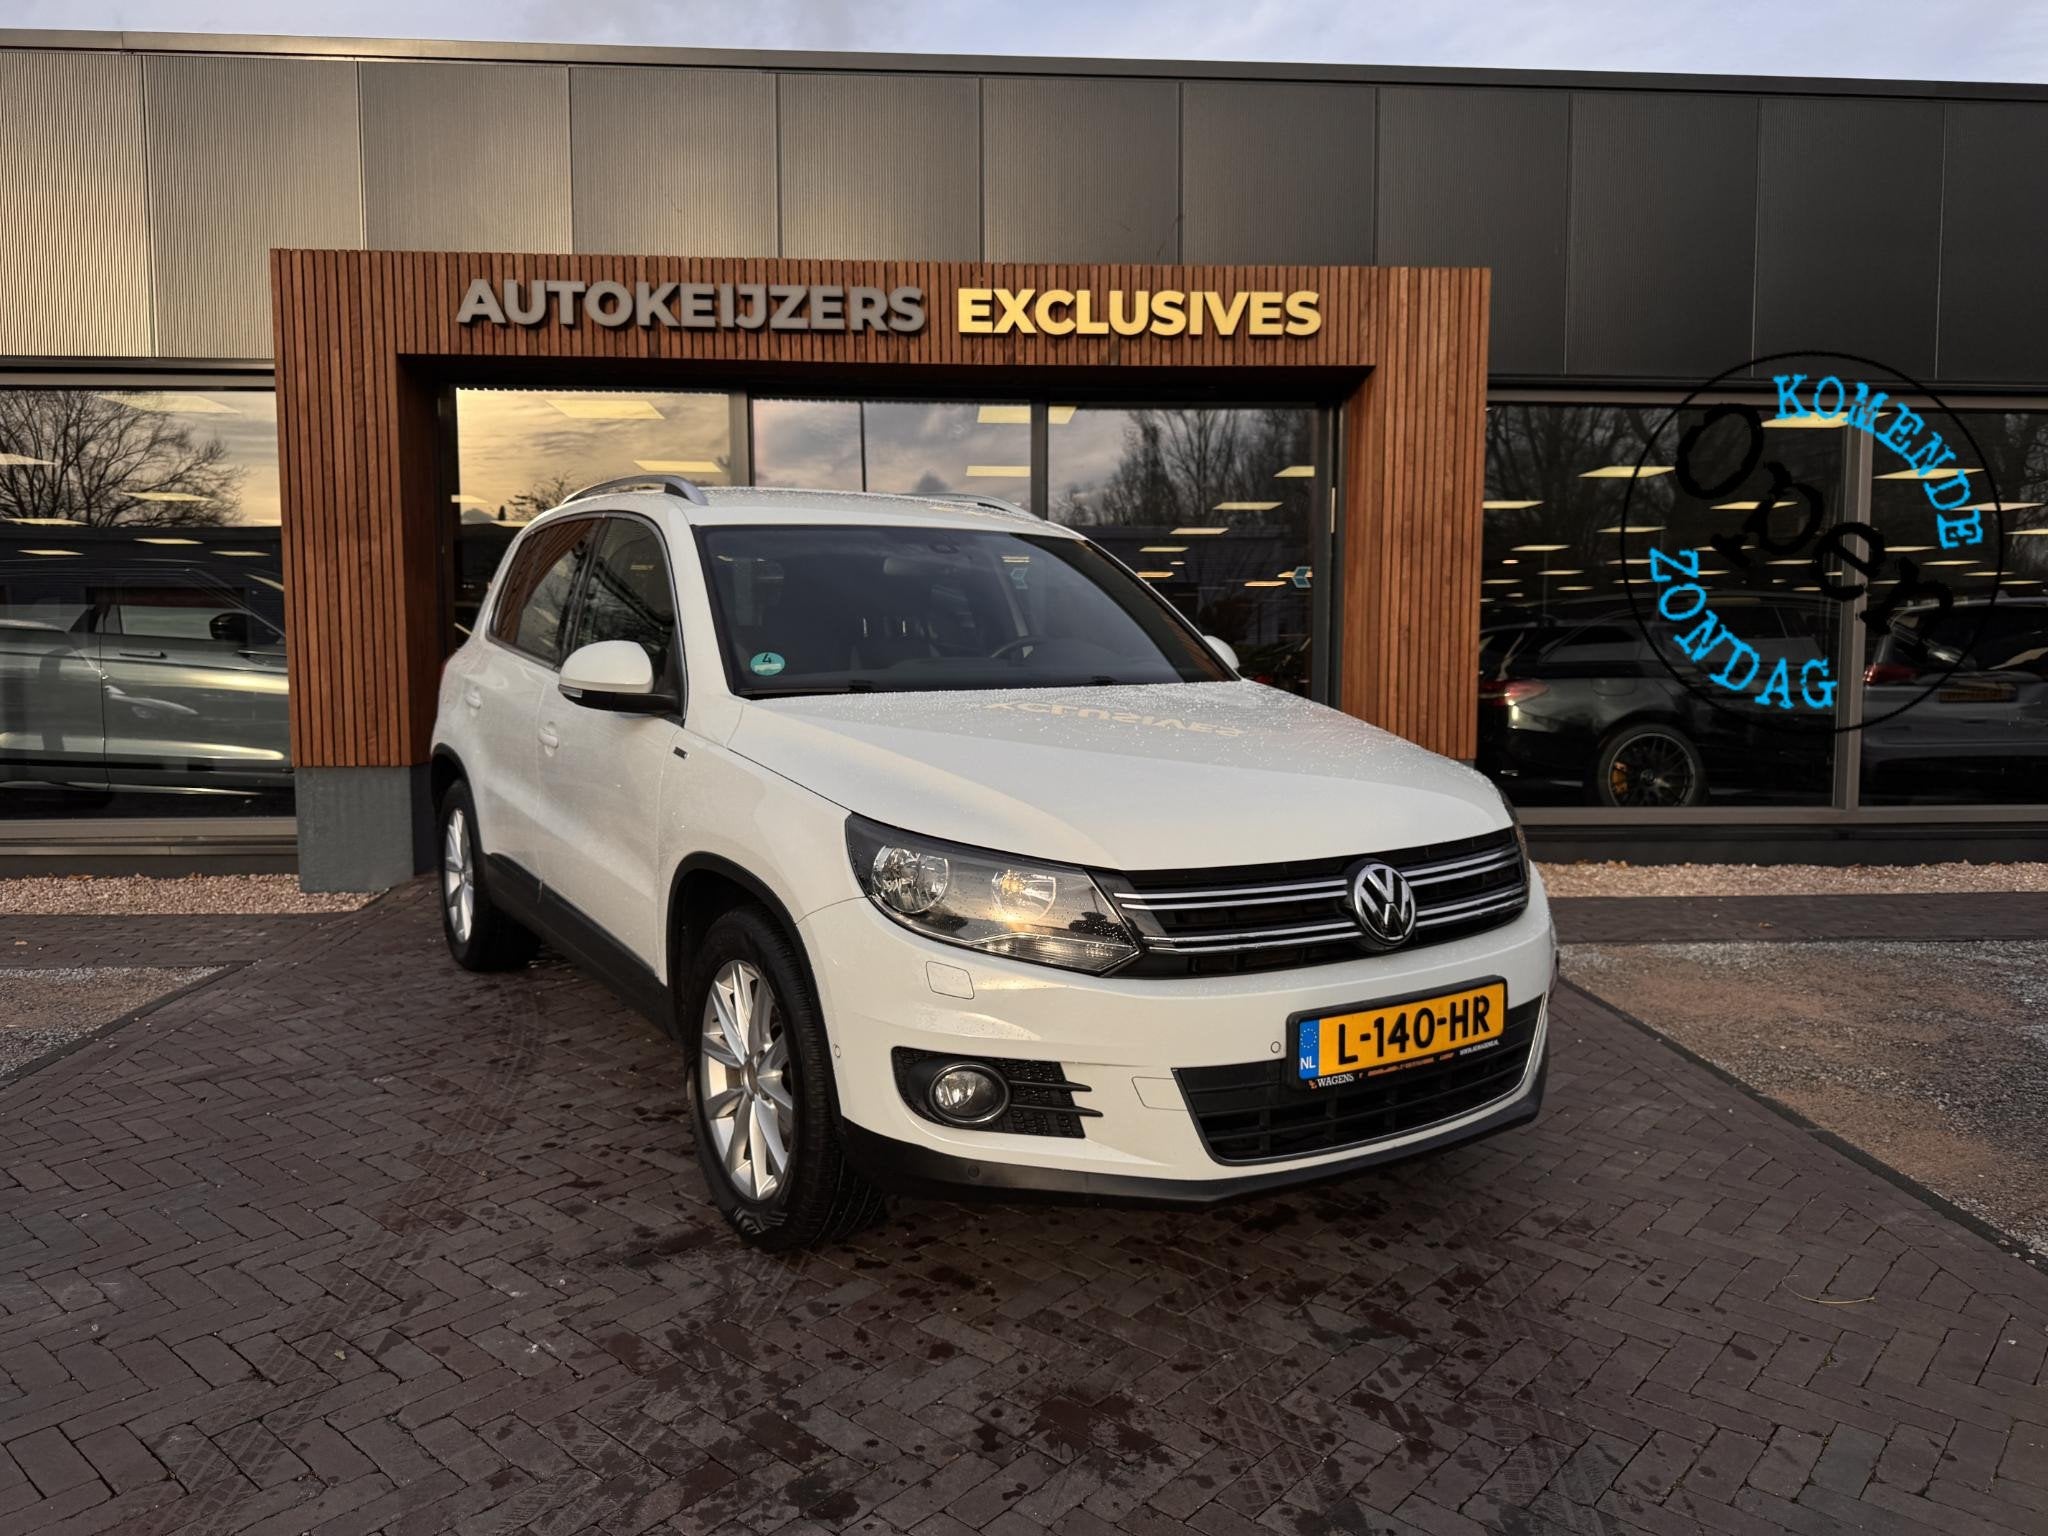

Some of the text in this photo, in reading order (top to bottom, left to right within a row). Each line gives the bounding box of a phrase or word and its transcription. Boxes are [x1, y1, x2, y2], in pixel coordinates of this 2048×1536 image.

[456, 278, 1323, 337] AUTOKEIJZERS EXCLUSIVES
[762, 653, 772, 664] 4
[1338, 994, 1491, 1066] L-140-HR
[1300, 1056, 1317, 1071] NL
[1317, 1073, 1355, 1088] WAGENS
